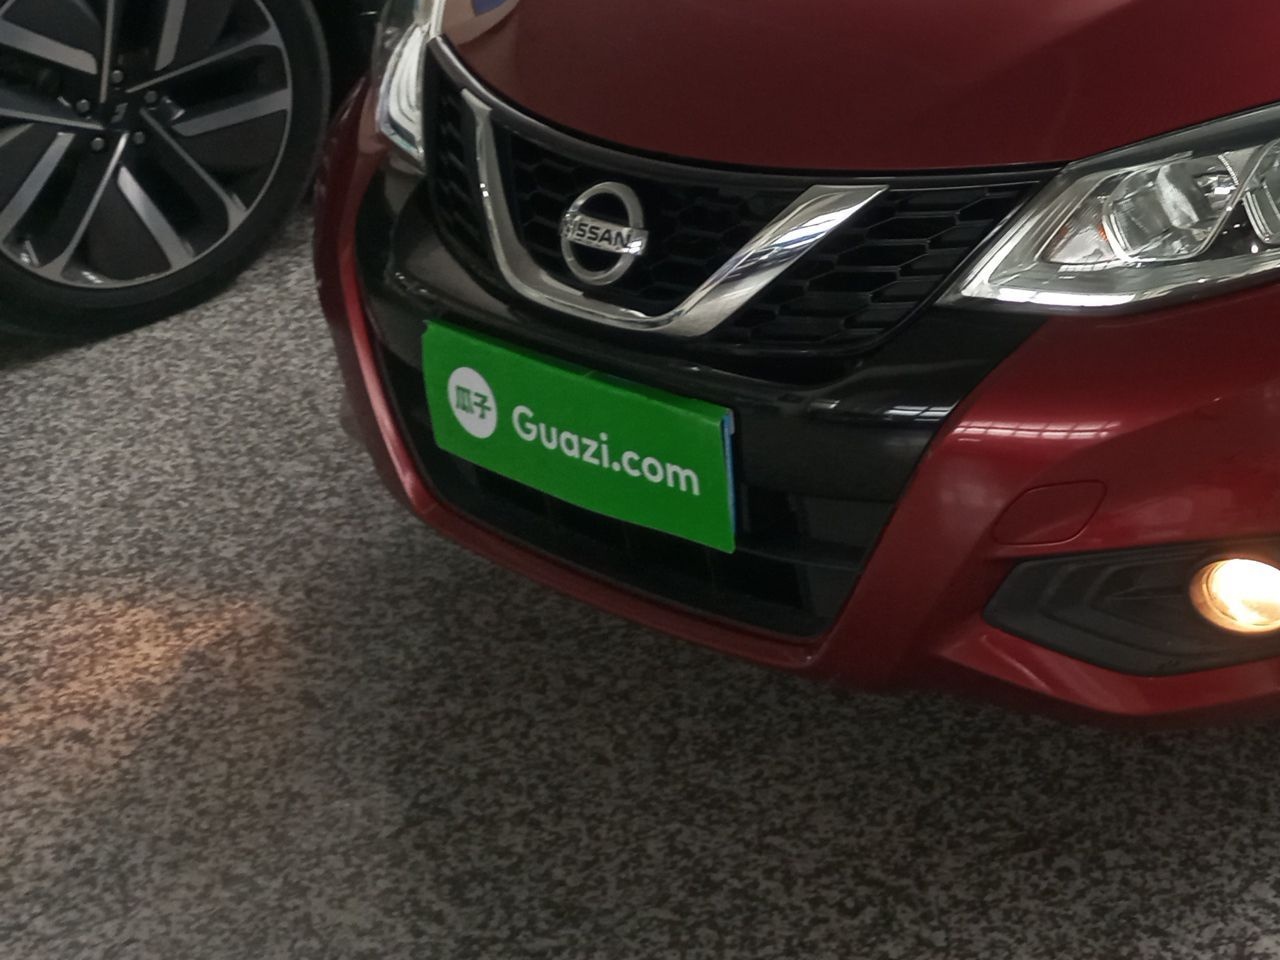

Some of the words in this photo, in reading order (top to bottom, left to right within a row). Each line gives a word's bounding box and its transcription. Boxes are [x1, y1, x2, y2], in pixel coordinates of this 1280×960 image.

[563, 220, 632, 248] NISSAN
[454, 385, 493, 419] 瓜子
[511, 404, 701, 496] Guazi.com
